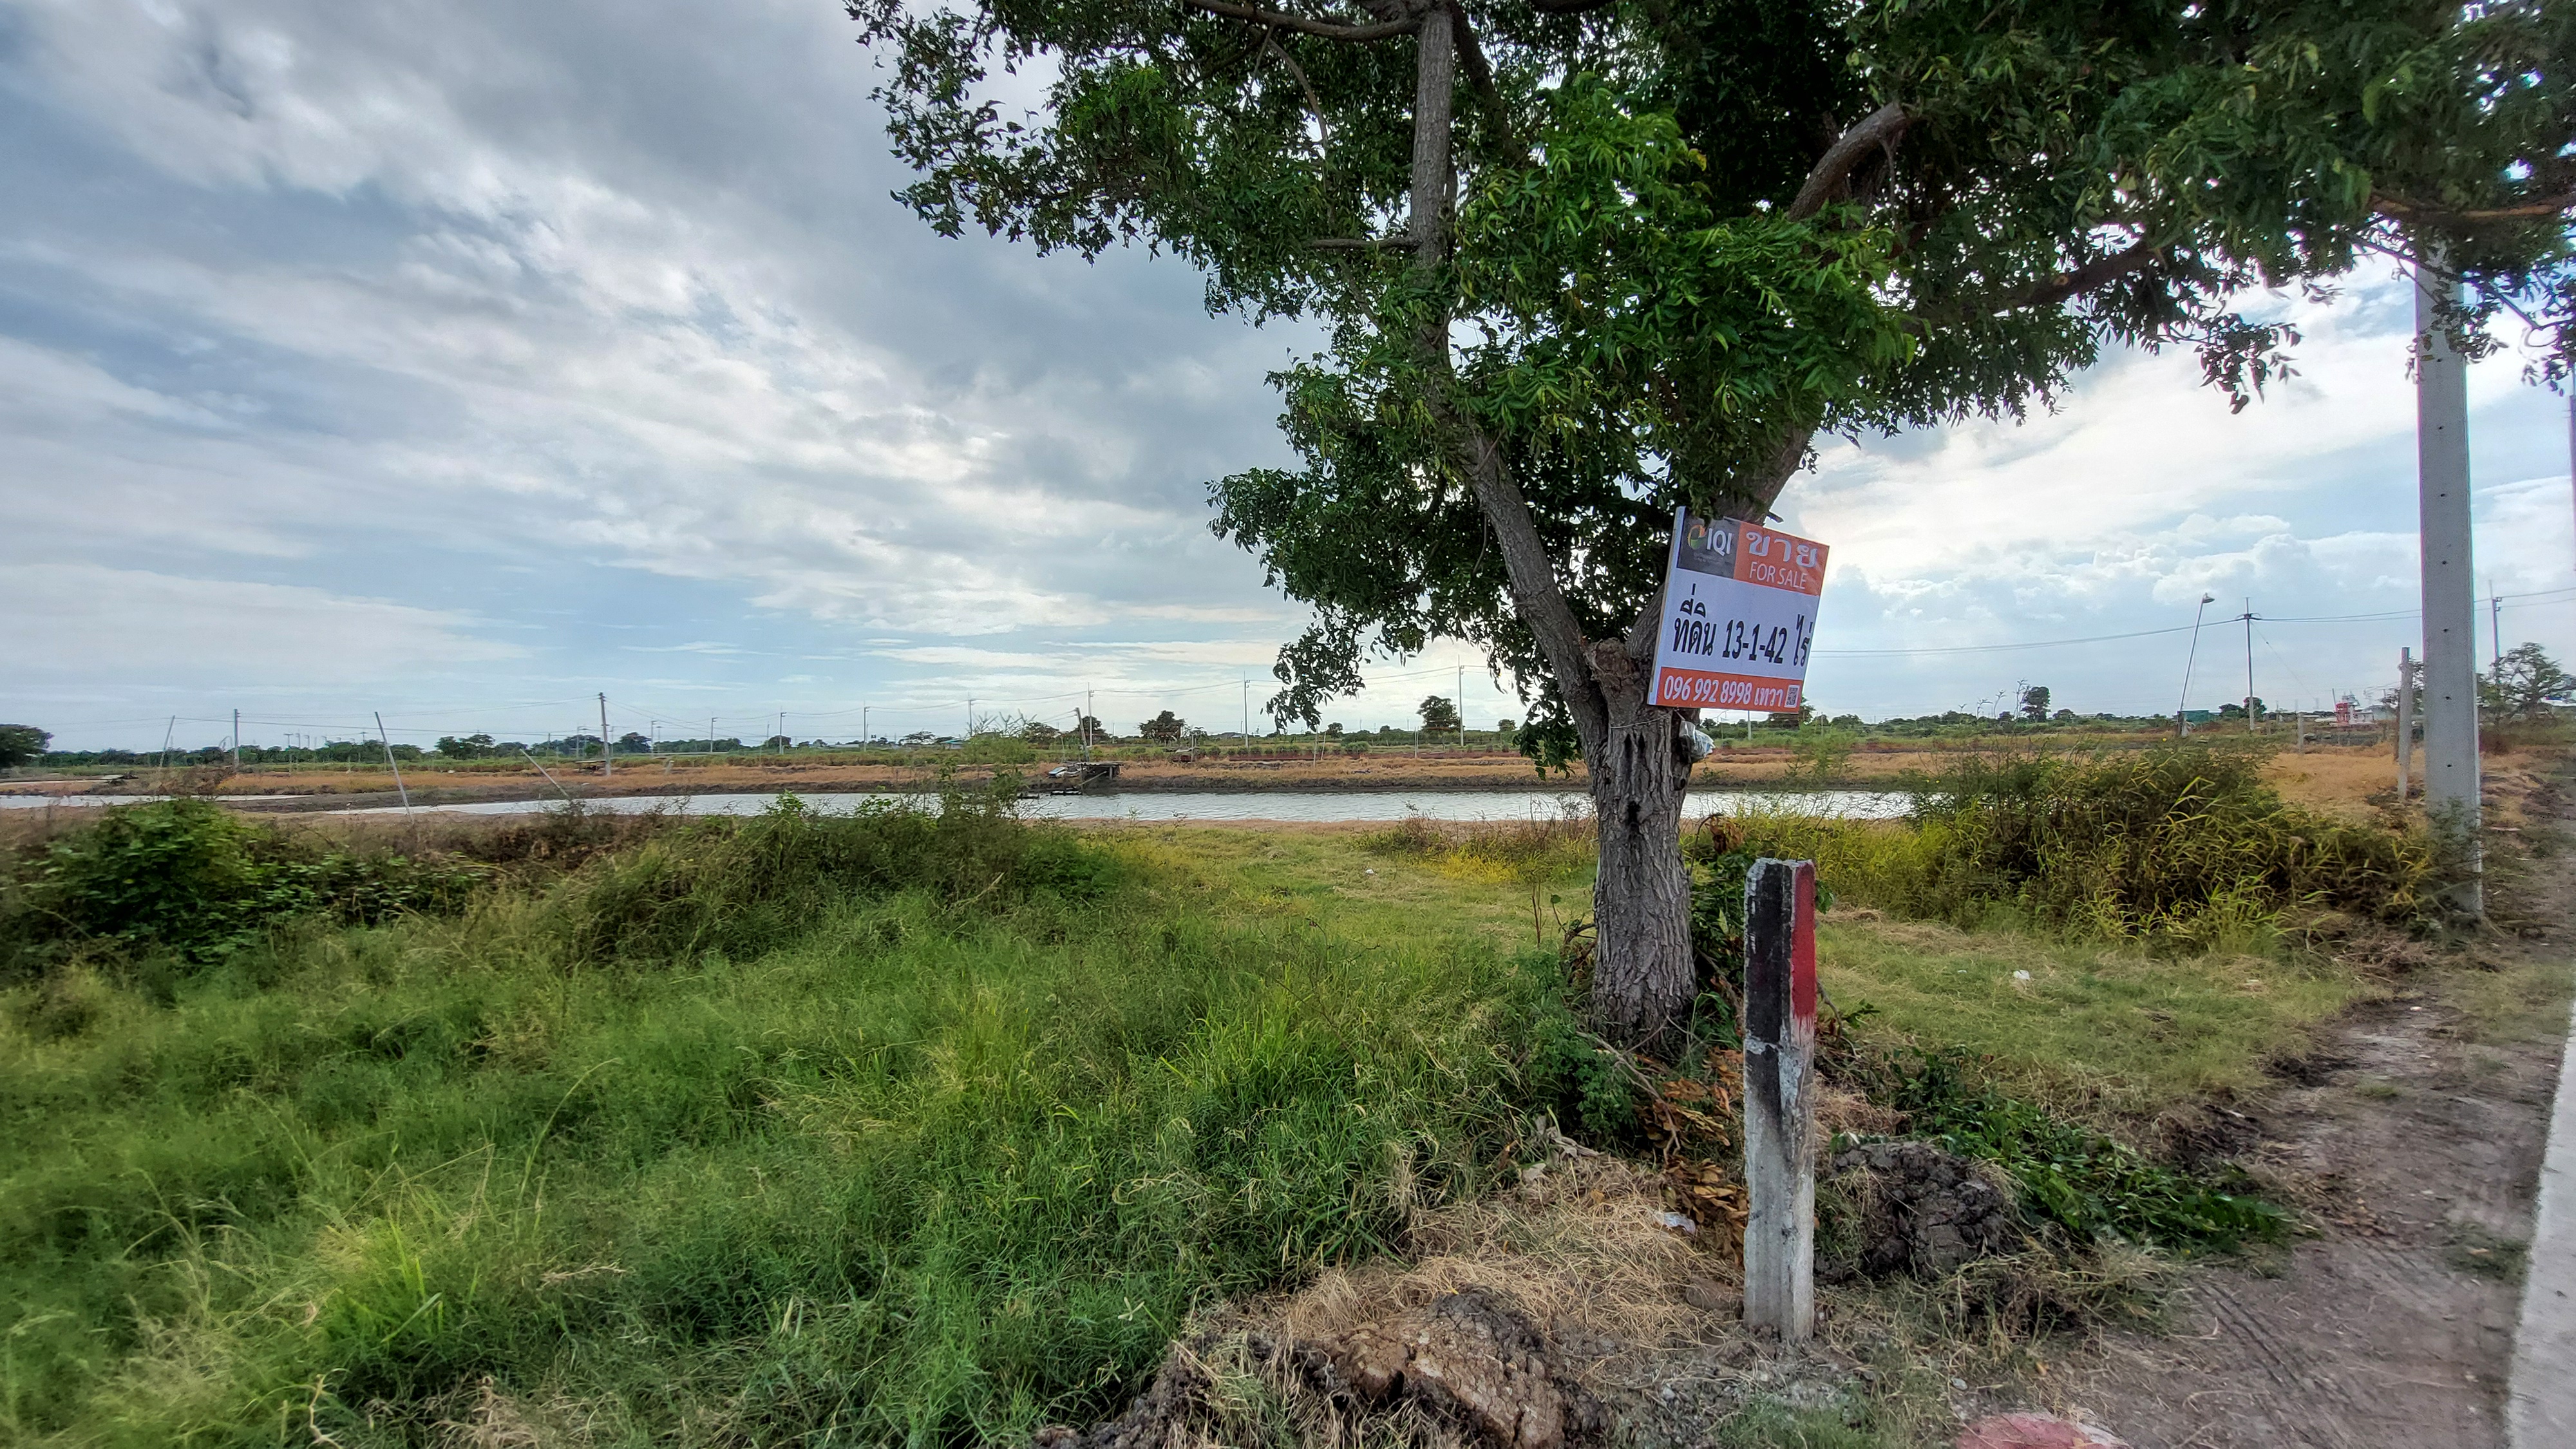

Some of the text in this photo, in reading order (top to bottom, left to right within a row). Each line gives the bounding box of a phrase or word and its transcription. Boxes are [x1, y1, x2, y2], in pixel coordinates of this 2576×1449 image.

[1707, 528, 1732, 556] IQI
[1746, 531, 1817, 567] ขาย
[1749, 562, 1808, 589] FOR SALE
[1672, 583, 1813, 667] ที่ดิน 13-1-42 ไร่
[1664, 675, 1783, 706] 096 992 8998 เทวา
